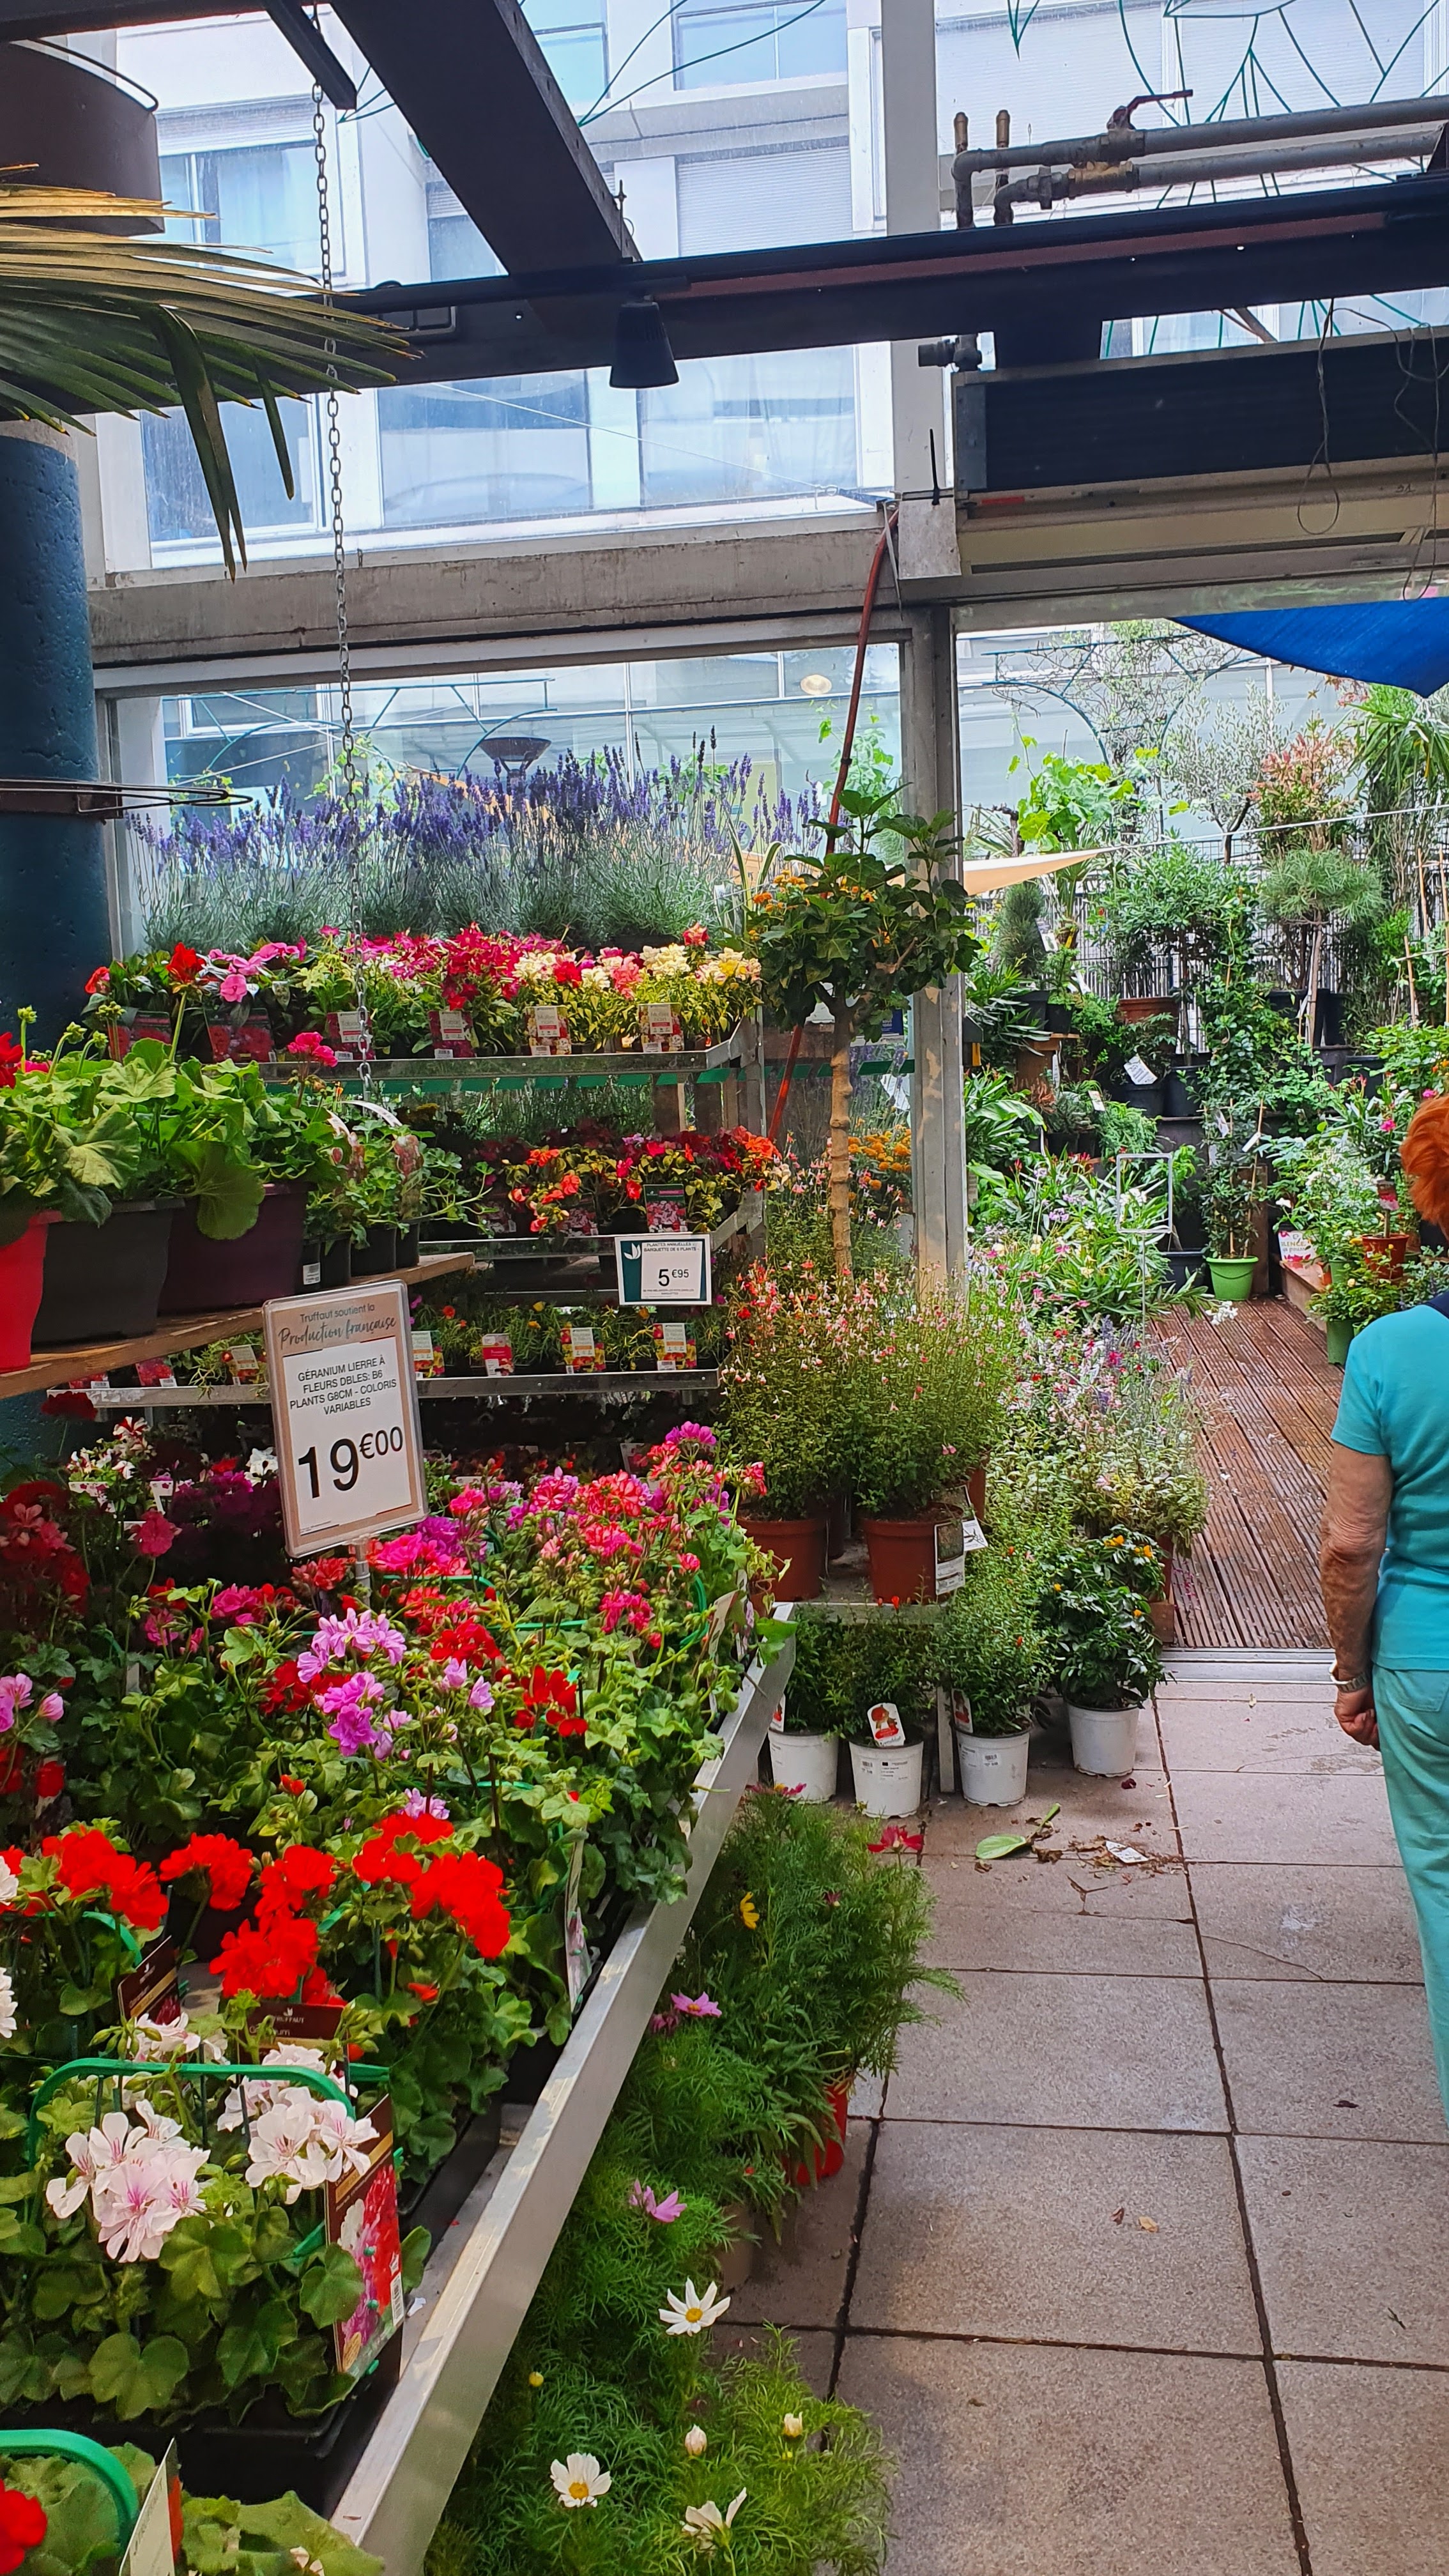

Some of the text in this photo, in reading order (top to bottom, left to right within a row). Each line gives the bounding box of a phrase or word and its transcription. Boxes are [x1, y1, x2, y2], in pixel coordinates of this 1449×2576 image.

[300, 1303, 375, 1323] Truffaut soutient la
[278, 1317, 397, 1350] Production française
[298, 1354, 386, 1381] GÉRANIUM LIERRE À
[303, 1369, 383, 1393] FLEURS DBLES: B6
[289, 1394, 326, 1409] PLANTS
[327, 1388, 353, 1402] G8CM
[360, 1379, 397, 1395] COLORIS
[323, 1397, 371, 1415] VARIABLES
